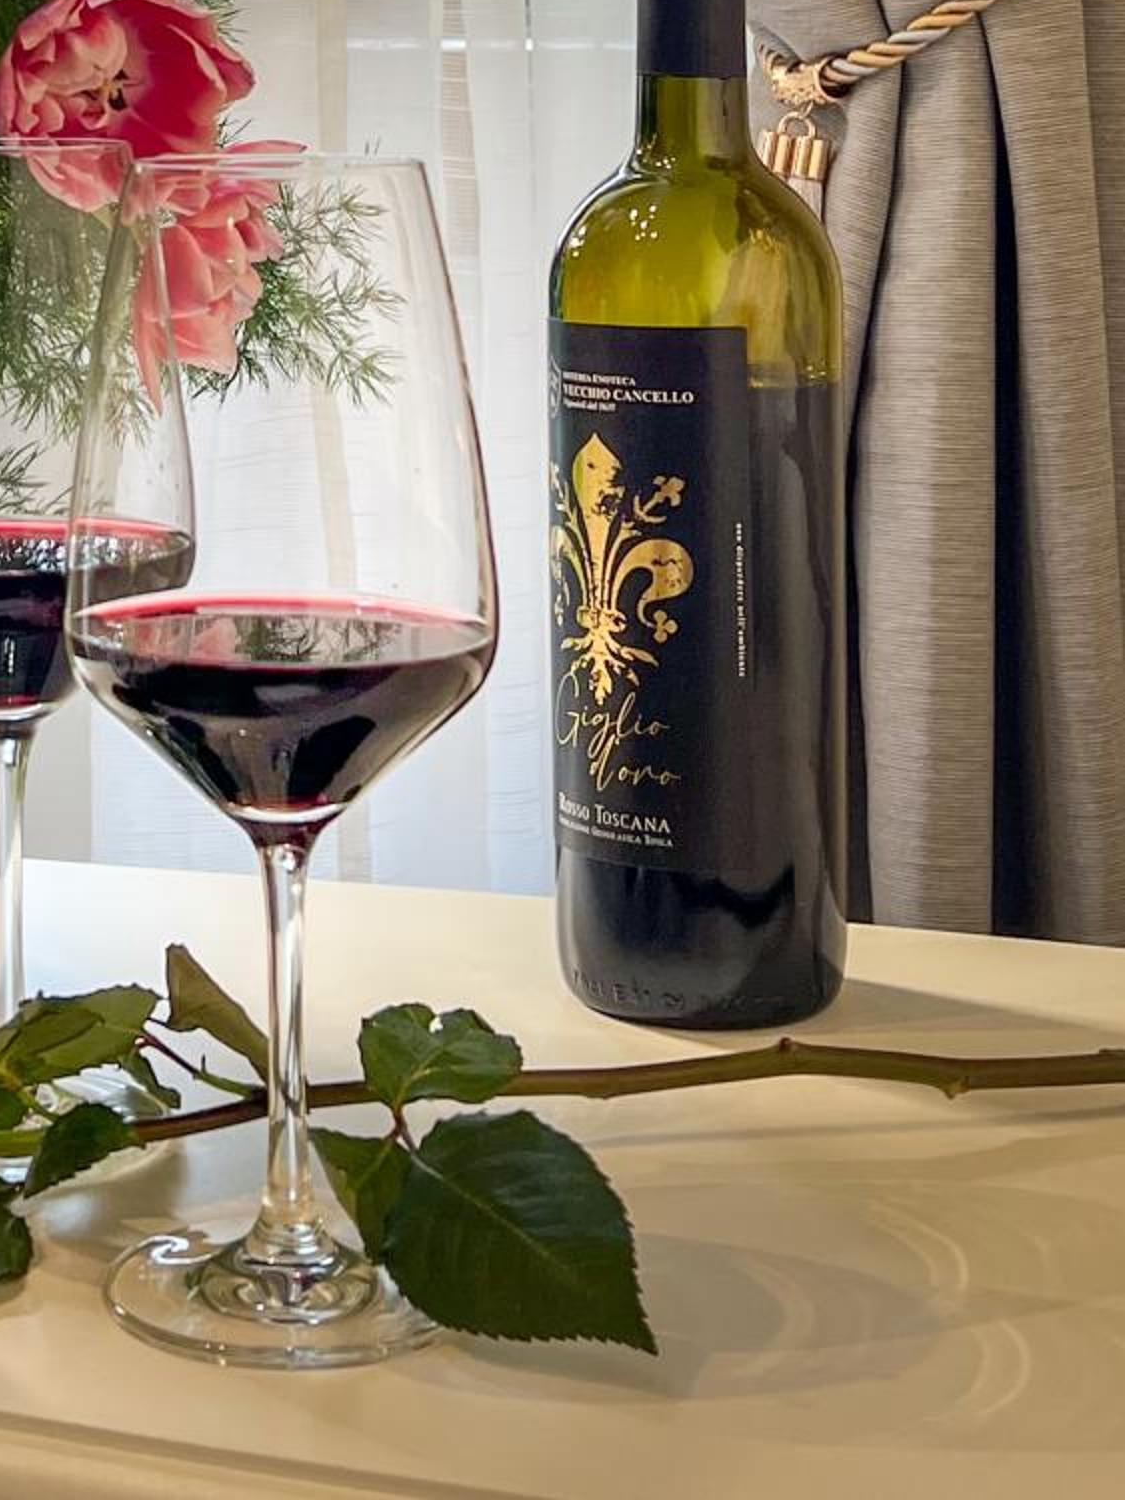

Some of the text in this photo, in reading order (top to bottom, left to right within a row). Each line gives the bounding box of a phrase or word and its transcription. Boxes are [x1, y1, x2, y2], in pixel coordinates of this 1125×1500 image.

[563, 383, 611, 400] VECCHIO
[612, 389, 695, 404] CANCELLO
[555, 671, 671, 759] Giglio
[594, 803, 671, 834] TOSCANA
